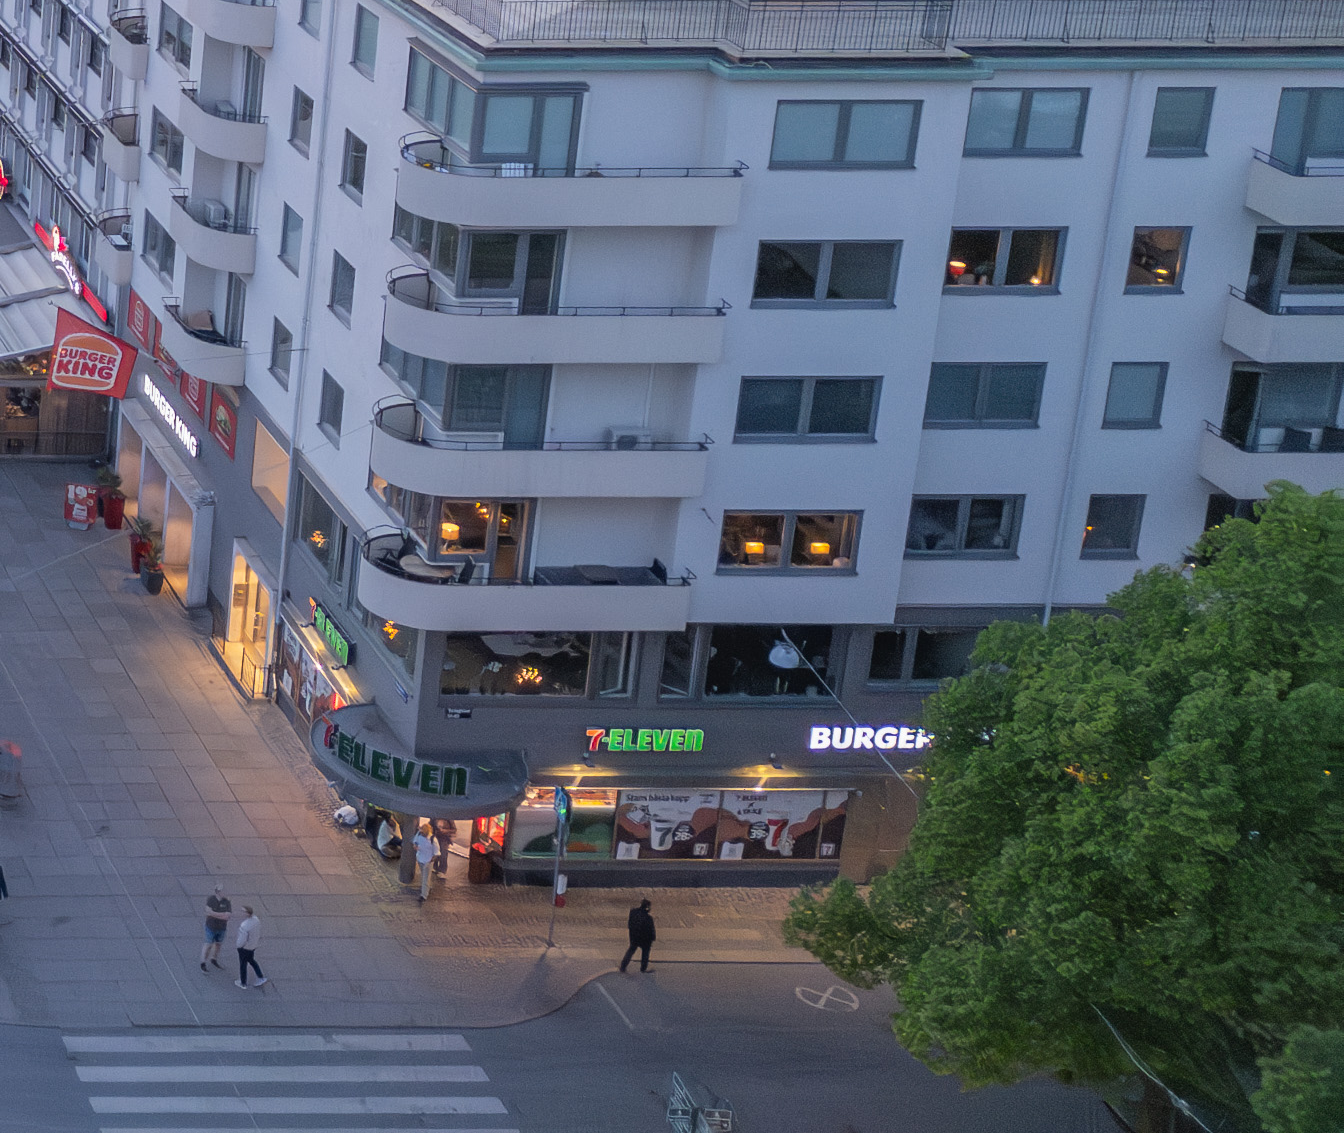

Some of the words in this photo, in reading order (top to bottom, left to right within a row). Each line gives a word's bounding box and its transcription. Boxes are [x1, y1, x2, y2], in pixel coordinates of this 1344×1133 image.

[59, 347, 117, 367] BURGER
[56, 359, 114, 380] KING
[144, 374, 176, 431] BURGER
[175, 417, 199, 458] KING
[586, 729, 704, 751] 7-ELEVEN
[322, 716, 469, 796] 7-ELEVEN
